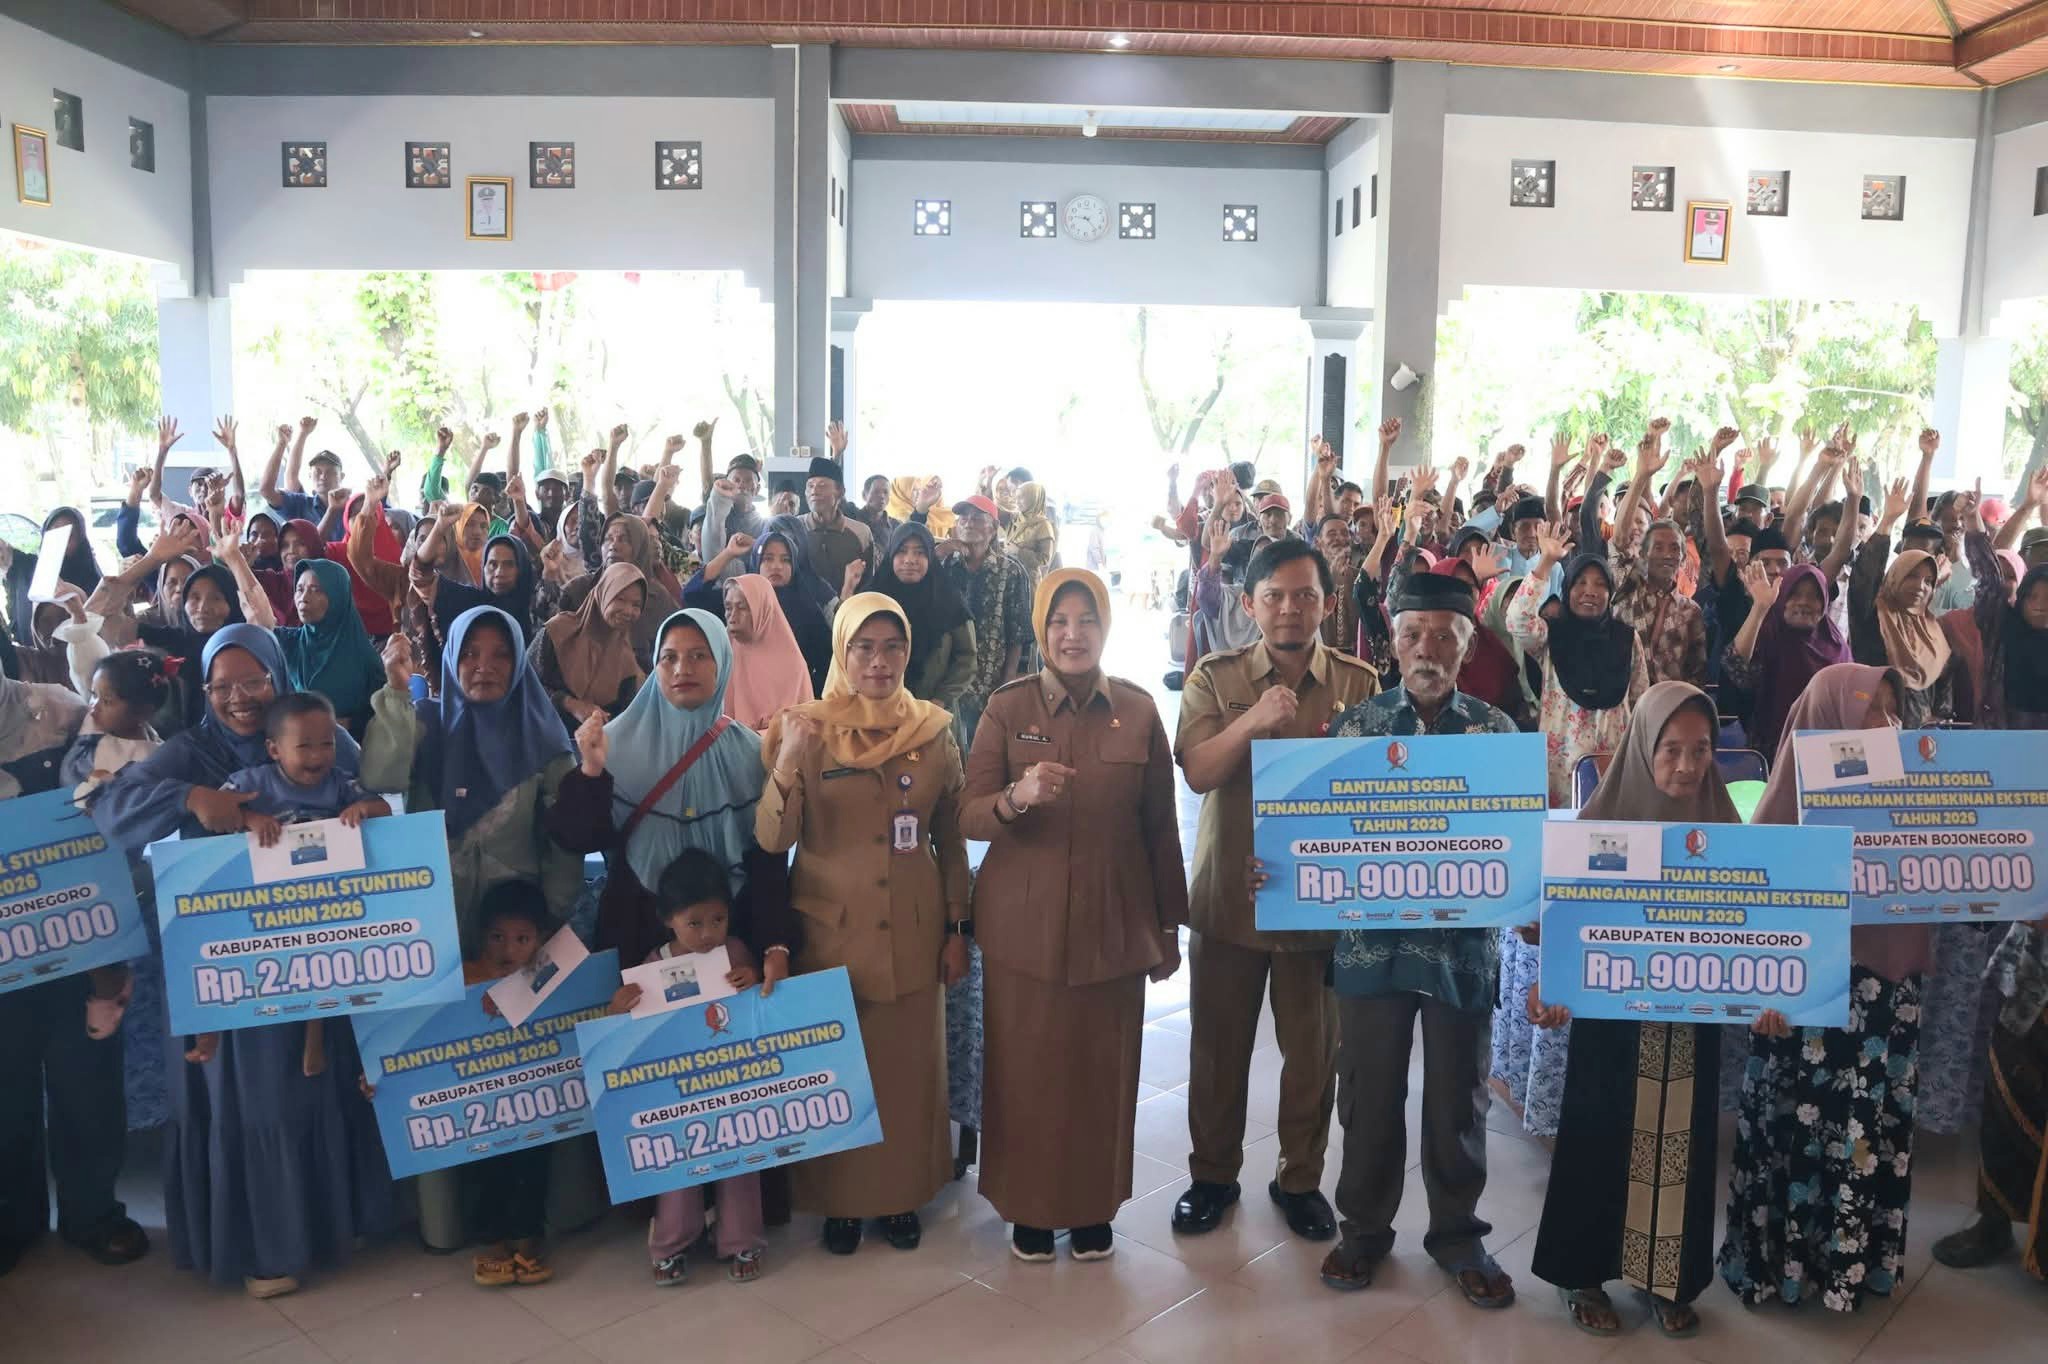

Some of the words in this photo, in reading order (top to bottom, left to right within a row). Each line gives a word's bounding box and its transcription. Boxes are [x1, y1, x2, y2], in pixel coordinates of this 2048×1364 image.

[1332, 780, 1408, 793] BANTUAN
[1411, 778, 1466, 792] SOSIAL
[1872, 773, 1939, 787] TUAN
[1942, 773, 1991, 786] SOSIAL
[1257, 801, 1367, 815] PENANGANAN
[1370, 799, 1468, 813] KEMISKINAN
[1471, 796, 1544, 811] EKSTREM
[1804, 793, 1904, 807] PENANGANAN
[1907, 792, 1993, 806] KEMISKINAN
[1997, 792, 2048, 805] EKSTRE
[1353, 819, 1408, 832] TAHUN
[1410, 818, 1447, 831] 2026
[1892, 812, 1941, 825] TAHUN
[1944, 811, 1976, 824] 2026
[9, 835, 104, 871] STUNTING
[1299, 841, 1391, 854] KABUPATEN
[1396, 839, 1503, 852] BOJONEGORO
[1854, 834, 1927, 846] ABUPATEN
[1932, 833, 2026, 845] BOJONEGORO
[178, 888, 268, 915] BANTUAN
[273, 881, 337, 902] SOSIAL
[340, 869, 431, 895] STUNTING
[1299, 863, 1352, 902] Rp.
[1359, 862, 1506, 899] 900.000
[1661, 868, 1706, 882] TUAN
[1709, 870, 1767, 885] SOSIAL
[1852, 856, 1896, 896] Rp.
[1900, 855, 2033, 892] 900.000
[0, 886, 91, 918] JONEGORO
[253, 906, 318, 929] TAHUN
[321, 900, 364, 920] 2026
[1547, 886, 1663, 901] PENANGANAN
[1665, 889, 1768, 905] KEMISKINAN
[1771, 892, 1848, 907] EKSTREM
[1647, 907, 1703, 922] TAHUN
[1706, 909, 1745, 924] 2026
[209, 935, 302, 957] KABUPATEN
[307, 921, 413, 944] BOJONEGORO
[1589, 929, 1684, 943] KABUPATEN
[1690, 931, 1802, 946] BOJONEGORO
[196, 967, 252, 1004] Rp.
[257, 941, 432, 995] 2.400.000
[1586, 952, 1641, 992] Rp.
[1649, 953, 1805, 995] 900.000
[383, 1041, 469, 1073] BANTUAN
[472, 1026, 532, 1049] SOSIAL
[534, 1007, 608, 1037] STUNTIN
[606, 1057, 692, 1088] BANTUAN
[695, 1044, 755, 1067] SOSIAL
[757, 1023, 842, 1052] STUNTING
[456, 1053, 517, 1077] TAHUN
[519, 1040, 558, 1062] 2026
[679, 1069, 740, 1094] TAHUN
[742, 1058, 781, 1080] 2026
[418, 1077, 505, 1107] KABUPATEN
[508, 1057, 583, 1085] BOJONEGO
[639, 1096, 726, 1126] KABUPATEN
[731, 1073, 828, 1104] BOJONEGORO
[408, 1116, 463, 1148] Rp.
[466, 1079, 585, 1133] 2.400.0
[629, 1135, 684, 1170] Rp.
[687, 1090, 850, 1155] 2.400.000
